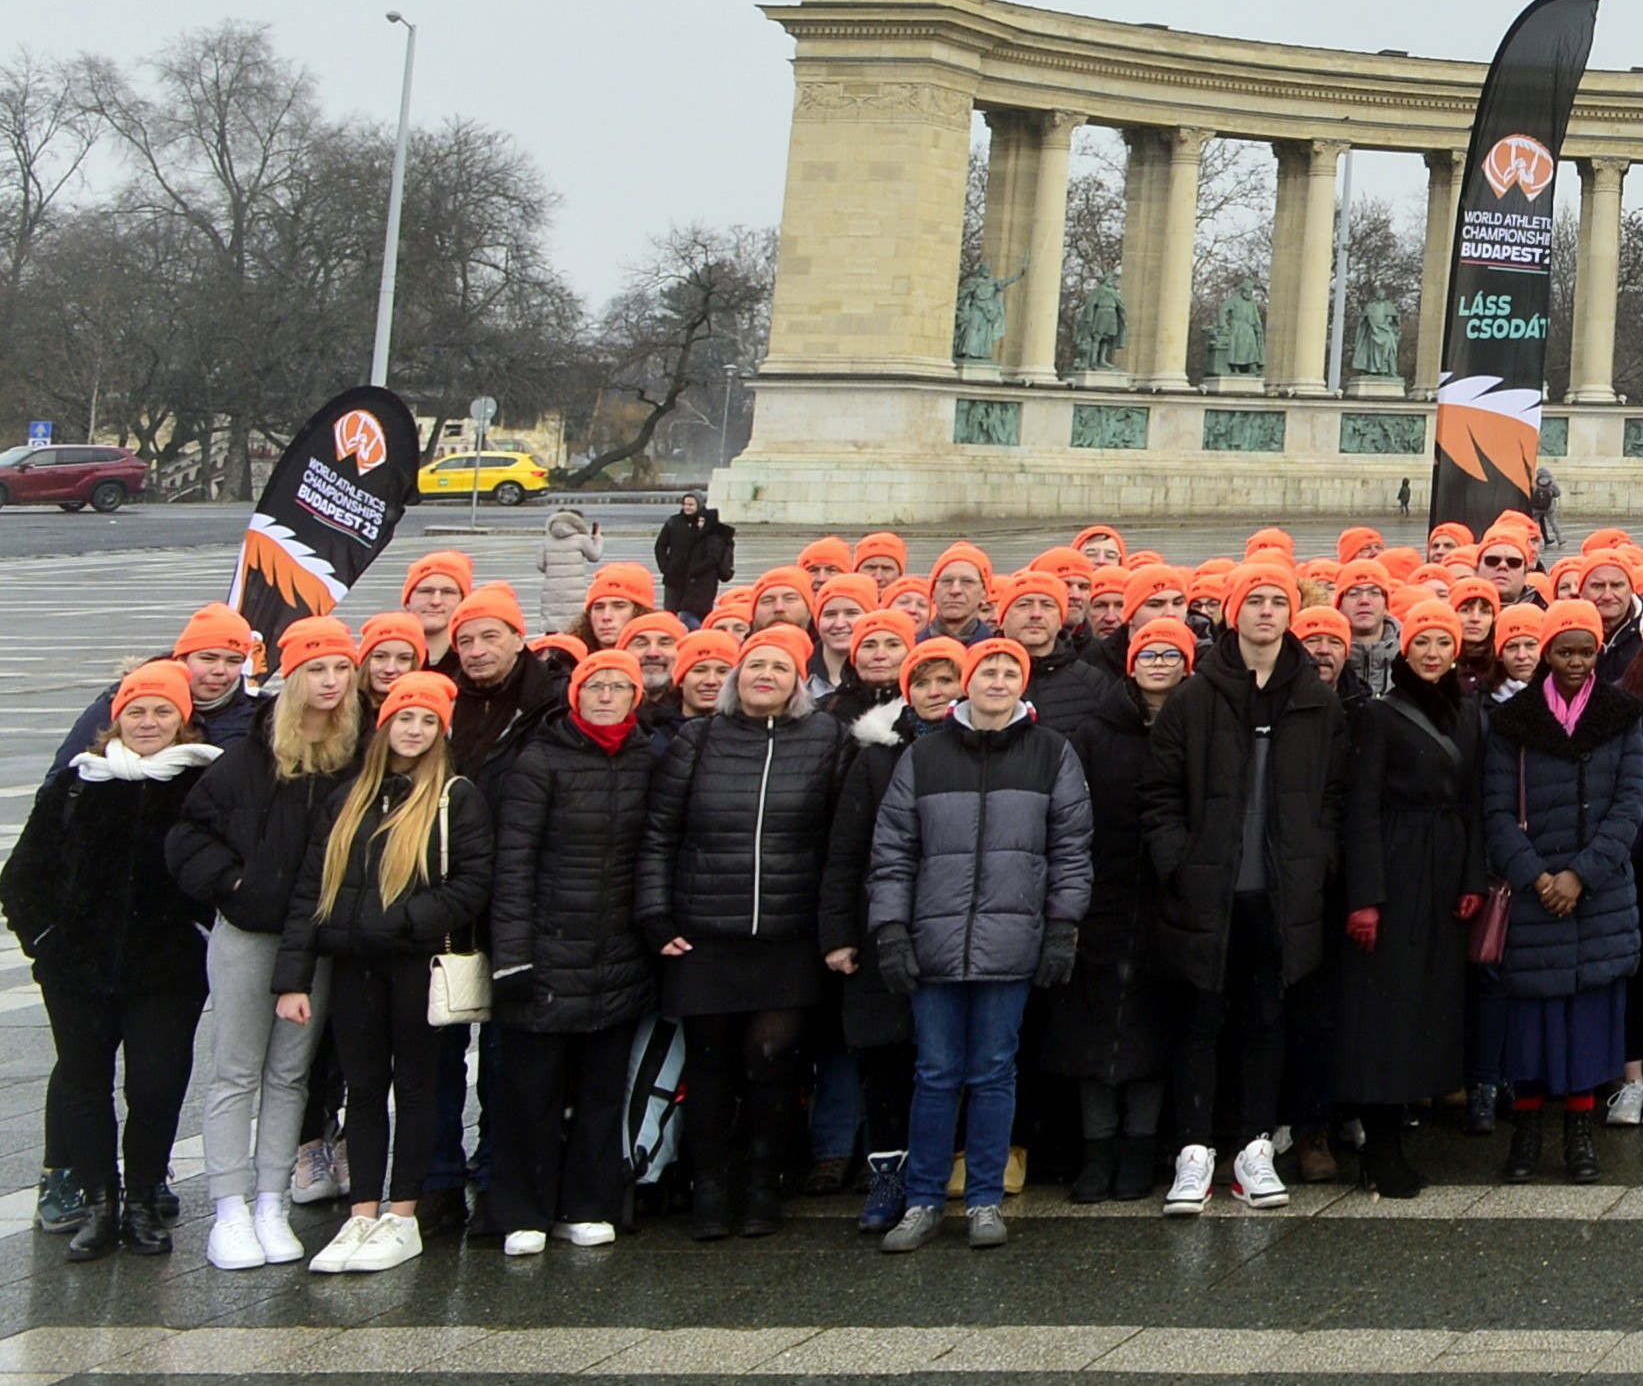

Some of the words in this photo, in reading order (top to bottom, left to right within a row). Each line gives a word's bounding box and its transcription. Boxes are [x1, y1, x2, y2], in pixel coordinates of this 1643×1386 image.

[1464, 210, 1502, 226] WORLD
[1460, 241, 1543, 264] BUDAPEST
[1458, 290, 1512, 316] LÁSS
[303, 469, 383, 525] CHAMPIONSHIPS
[308, 456, 338, 483] WORLD
[335, 477, 386, 512] ATHLETICS
[297, 483, 363, 530] BUDAPEST
[361, 521, 379, 540] 23
